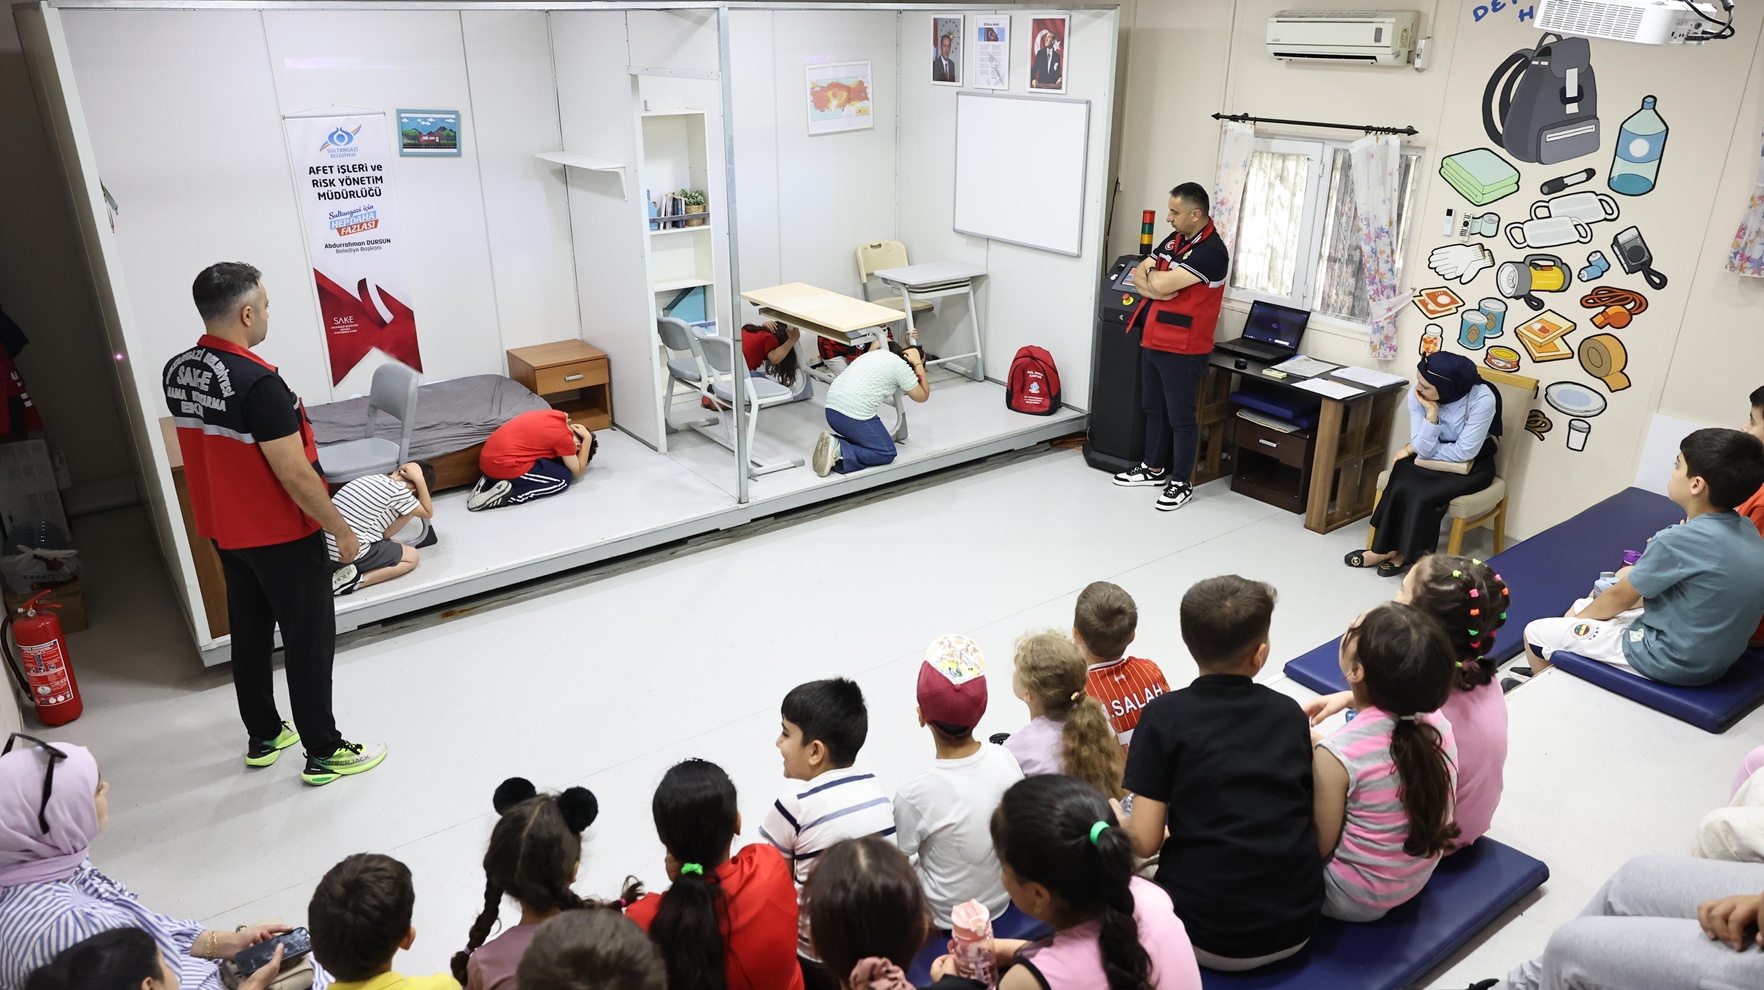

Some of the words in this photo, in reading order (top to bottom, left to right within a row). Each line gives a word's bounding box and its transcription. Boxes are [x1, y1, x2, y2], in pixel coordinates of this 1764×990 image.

[309, 166, 334, 175] AFET
[318, 187, 381, 200] MÜDÜRLÜĞÜ
[328, 206, 362, 220] Sultangazi
[363, 203, 374, 211] için
[331, 219, 350, 229] HEP
[350, 212, 375, 225] DAHA
